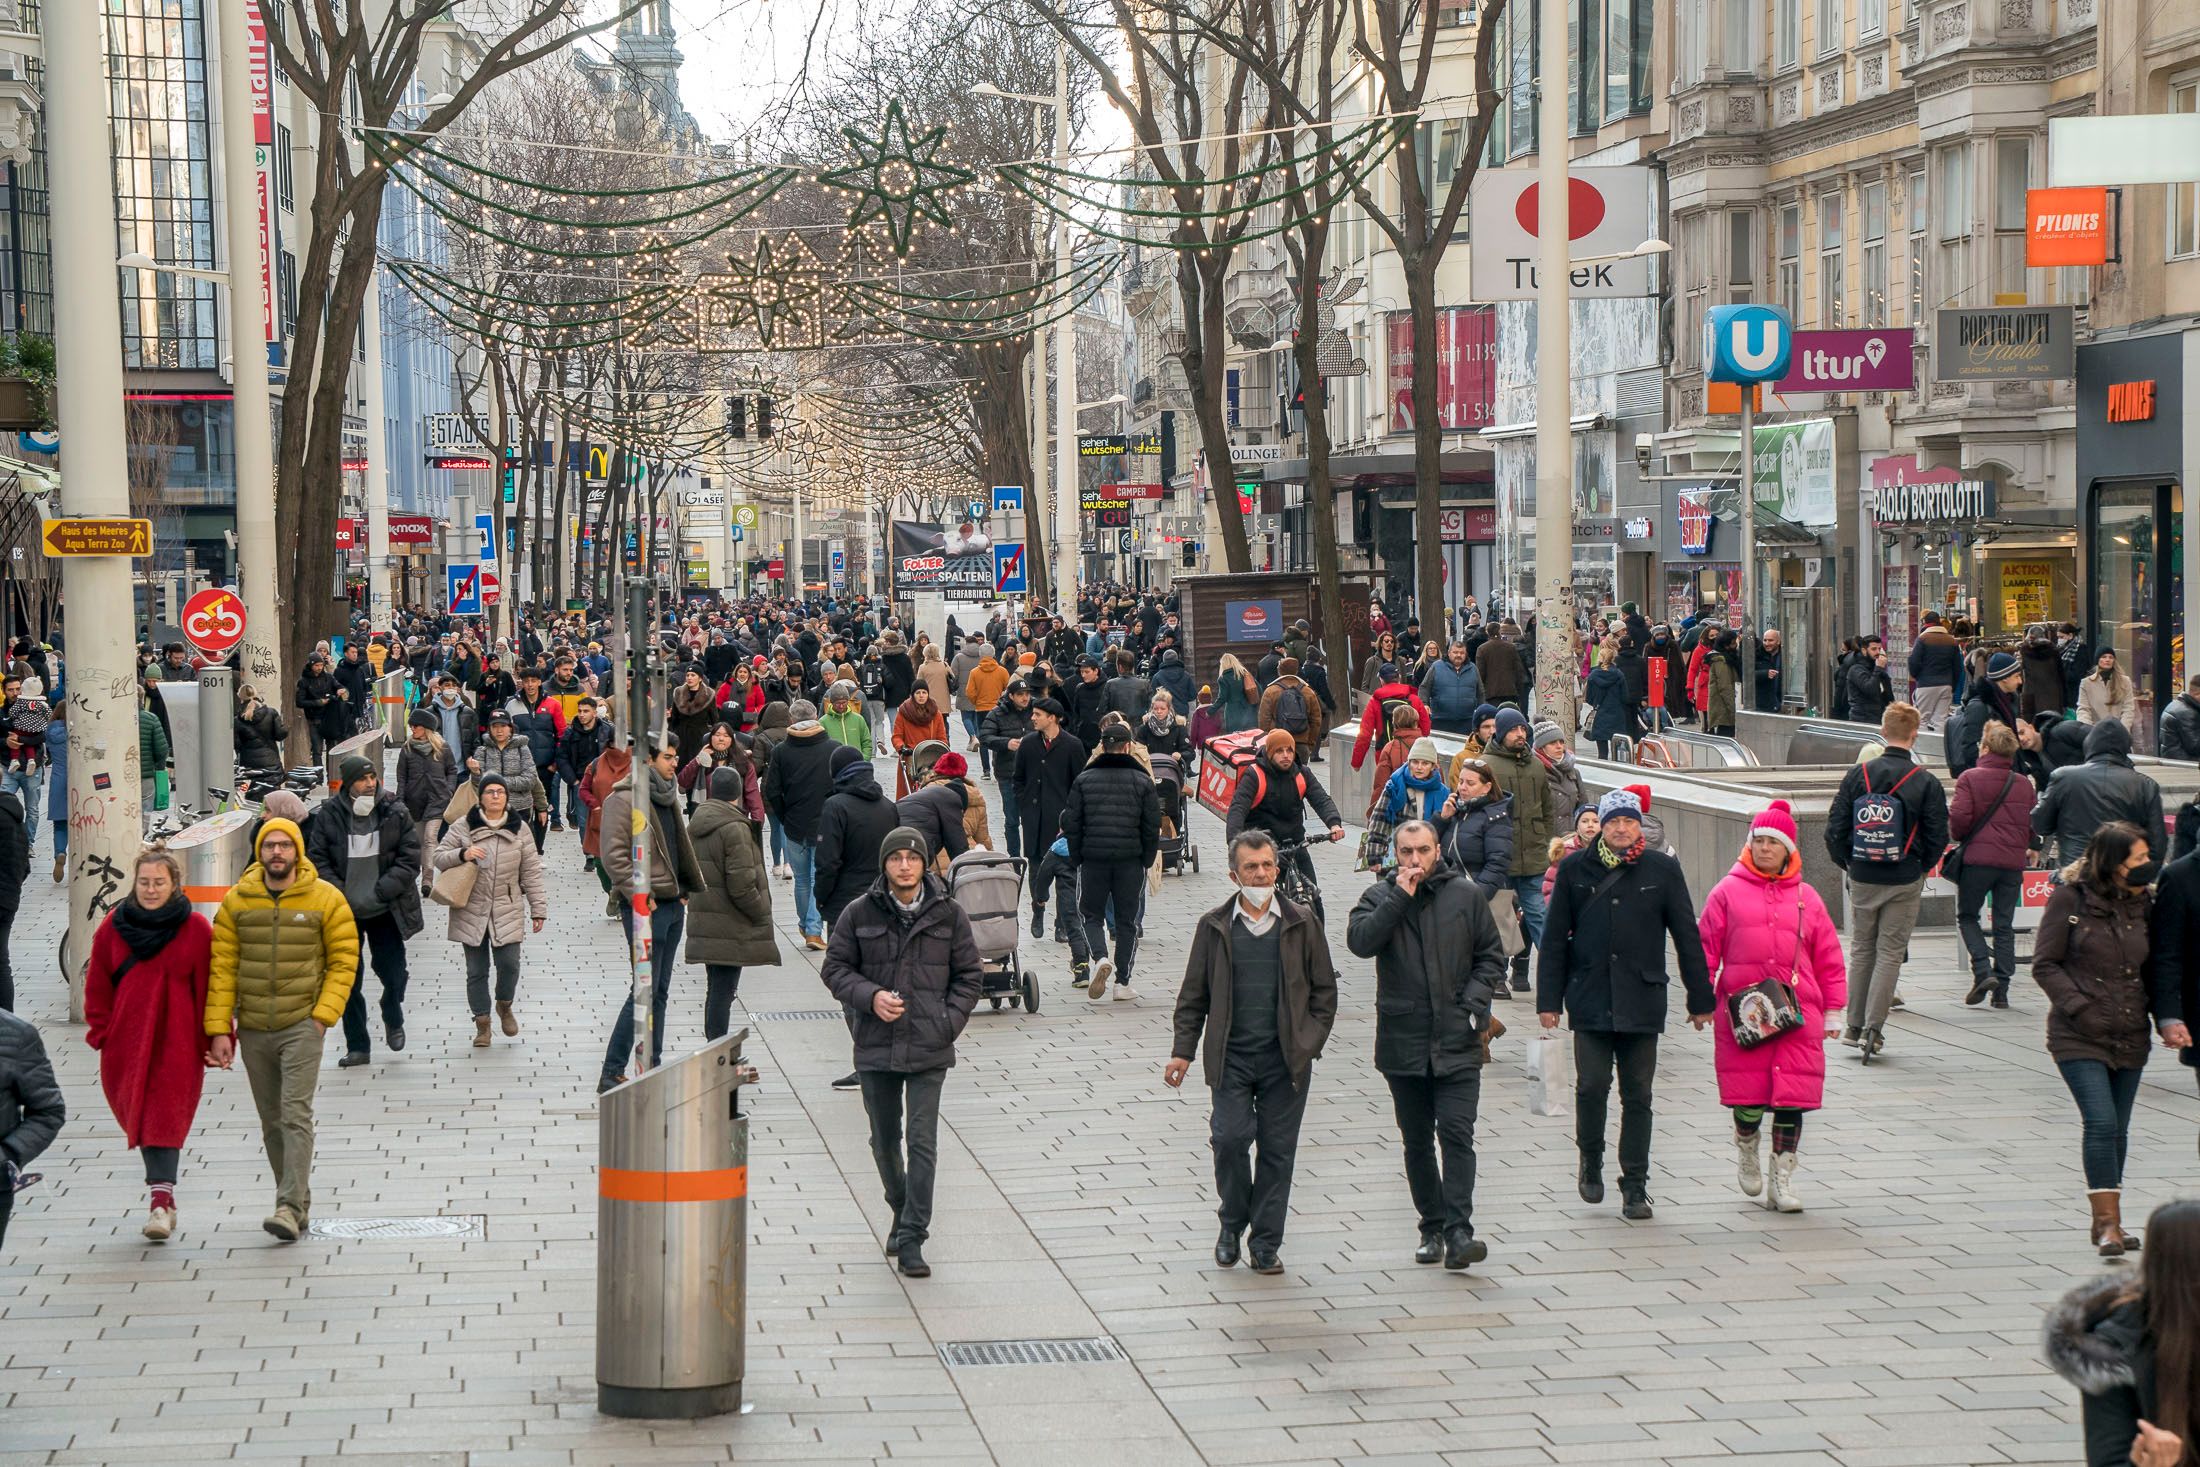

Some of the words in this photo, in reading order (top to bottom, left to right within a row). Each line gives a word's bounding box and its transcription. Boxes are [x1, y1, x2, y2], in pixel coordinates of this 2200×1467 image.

[2035, 213, 2099, 232] PYLONES
[1506, 258, 1613, 289] Tuek
[1959, 313, 2049, 346] BORTOLOTTI
[1732, 320, 1779, 371] U
[1968, 326, 2046, 365] Paolo
[1803, 350, 1866, 380] ltur
[1081, 438, 1108, 448] sehen!
[1081, 446, 1124, 455] wutscher
[1116, 488, 1146, 497] CAMPER
[1082, 500, 1128, 509] wutscher
[1873, 486, 1908, 521] PAOLO
[1911, 481, 1984, 520] BORTOLOTTI
[973, 503, 983, 517] U
[61, 525, 81, 536] Haus
[83, 525, 97, 536] des
[99, 525, 129, 536] Meeres
[65, 538, 85, 551] Aqua
[88, 538, 108, 549] Terra
[111, 538, 126, 549] Zoo
[903, 557, 944, 570] FOLTER
[2003, 564, 2050, 575] AKTION
[2003, 579, 2050, 588] LAMMFELL
[947, 590, 992, 599] TIERFABRIKEN
[2012, 593, 2040, 602] LEDER
[197, 619, 232, 629] citybike
[203, 676, 224, 688] 601
